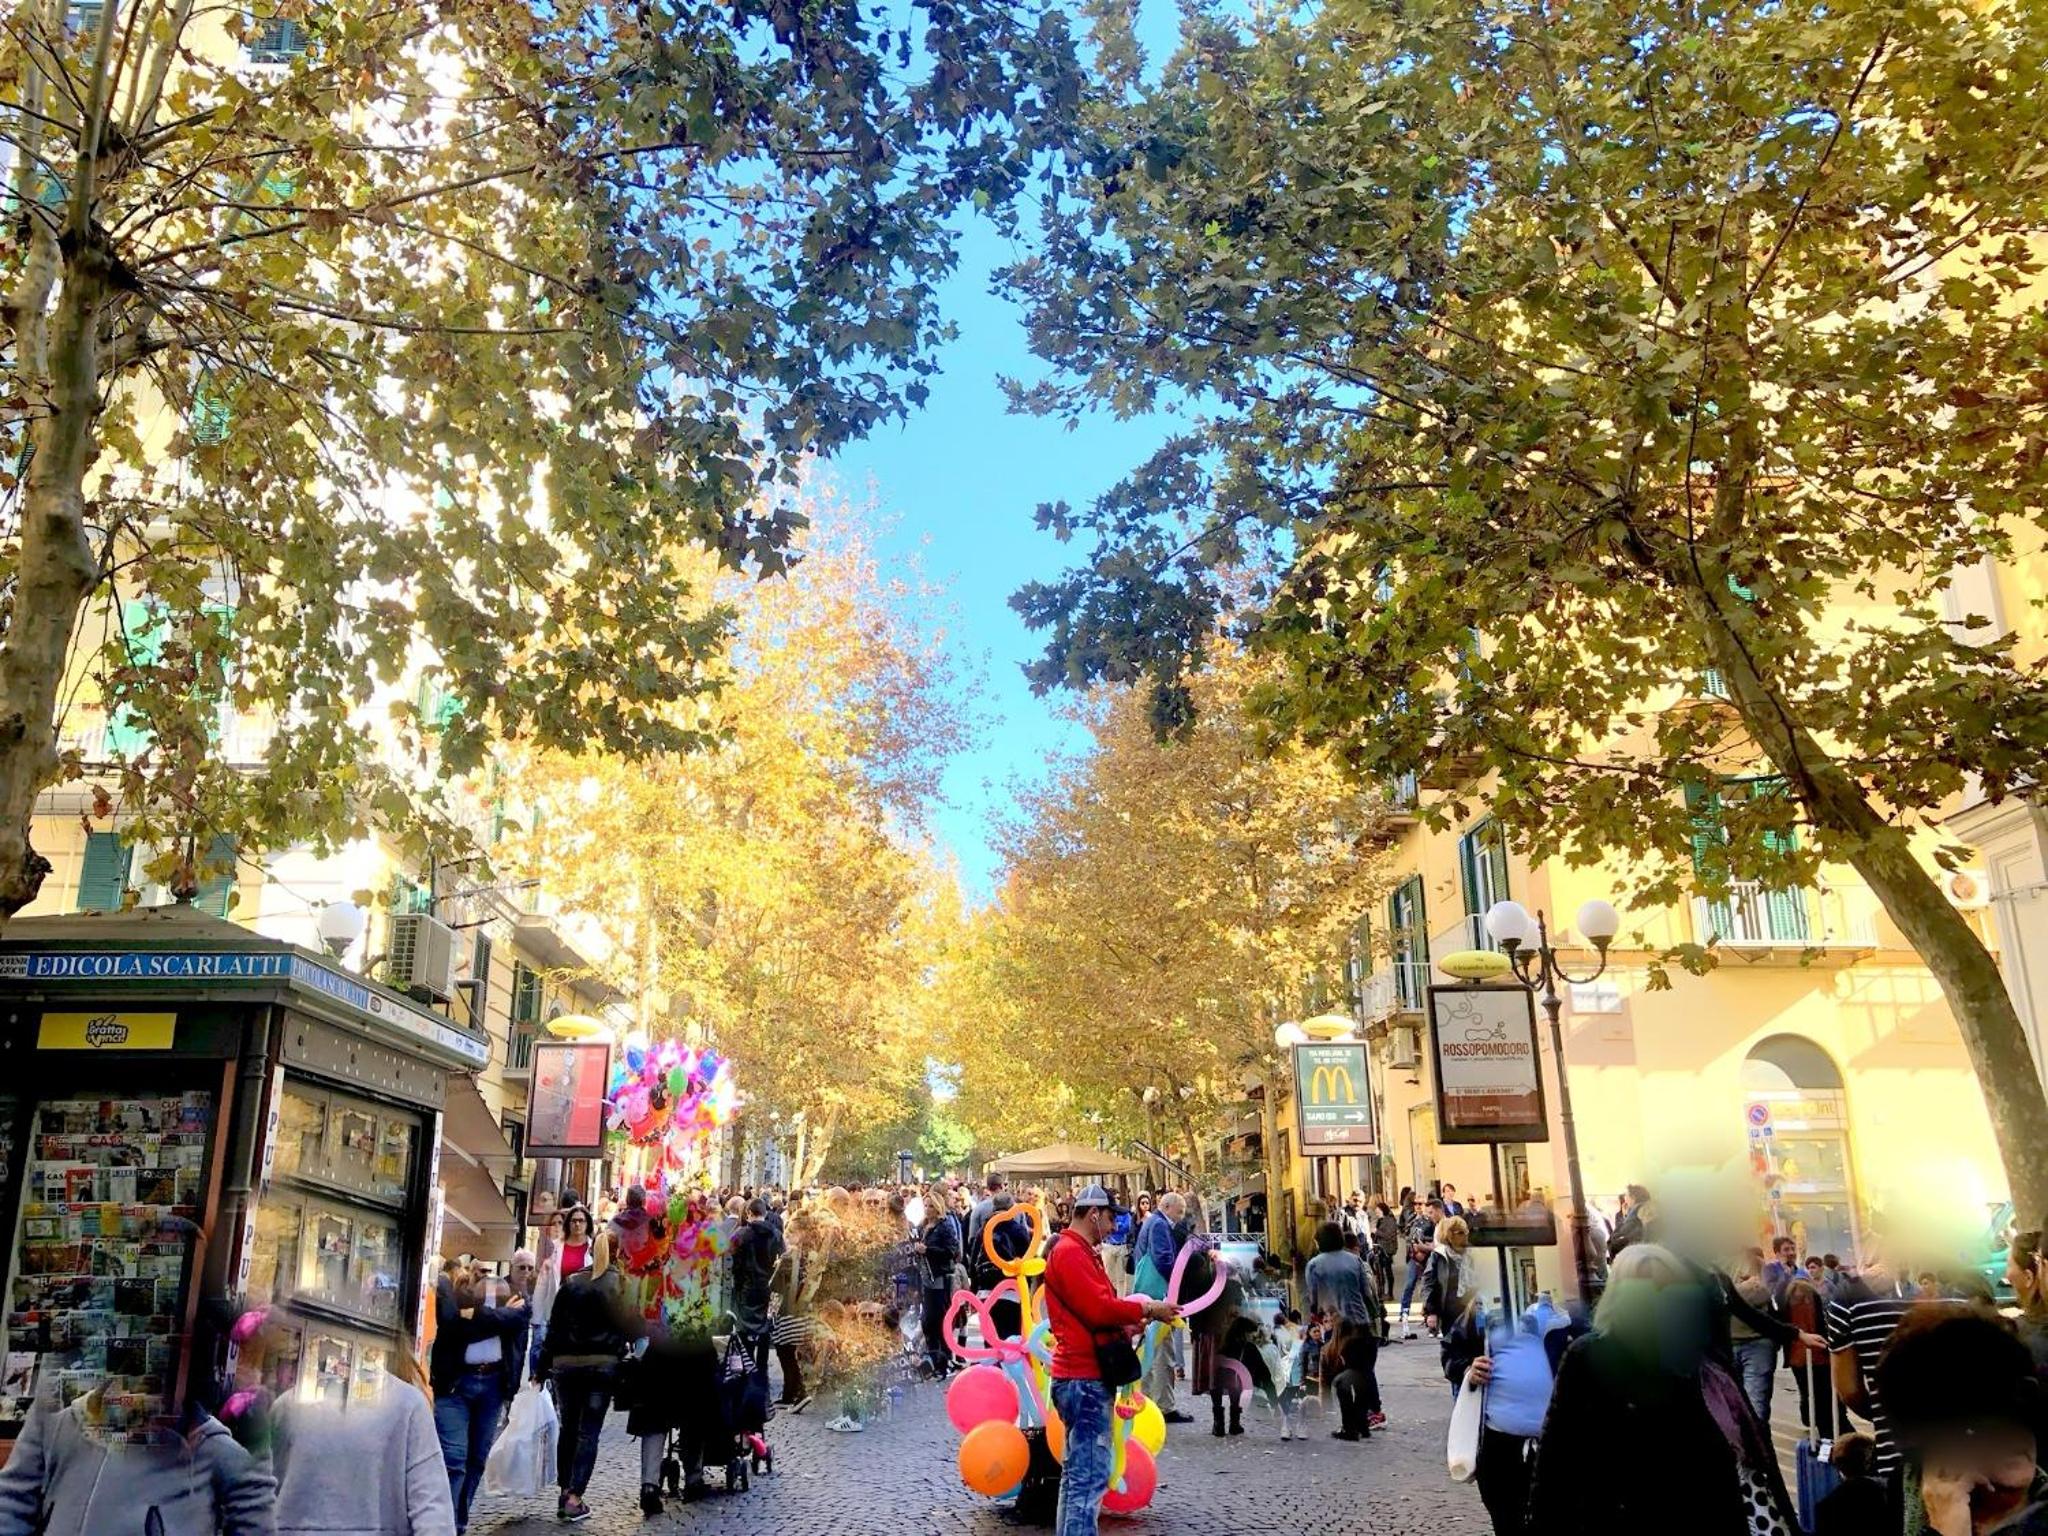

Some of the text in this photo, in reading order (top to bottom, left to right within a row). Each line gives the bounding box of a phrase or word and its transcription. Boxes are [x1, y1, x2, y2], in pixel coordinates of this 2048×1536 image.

[35, 956, 143, 976] EDICOLA
[148, 956, 283, 976] SCARLATTI
[1443, 1043, 1530, 1057] ROSSOPOMODORO
